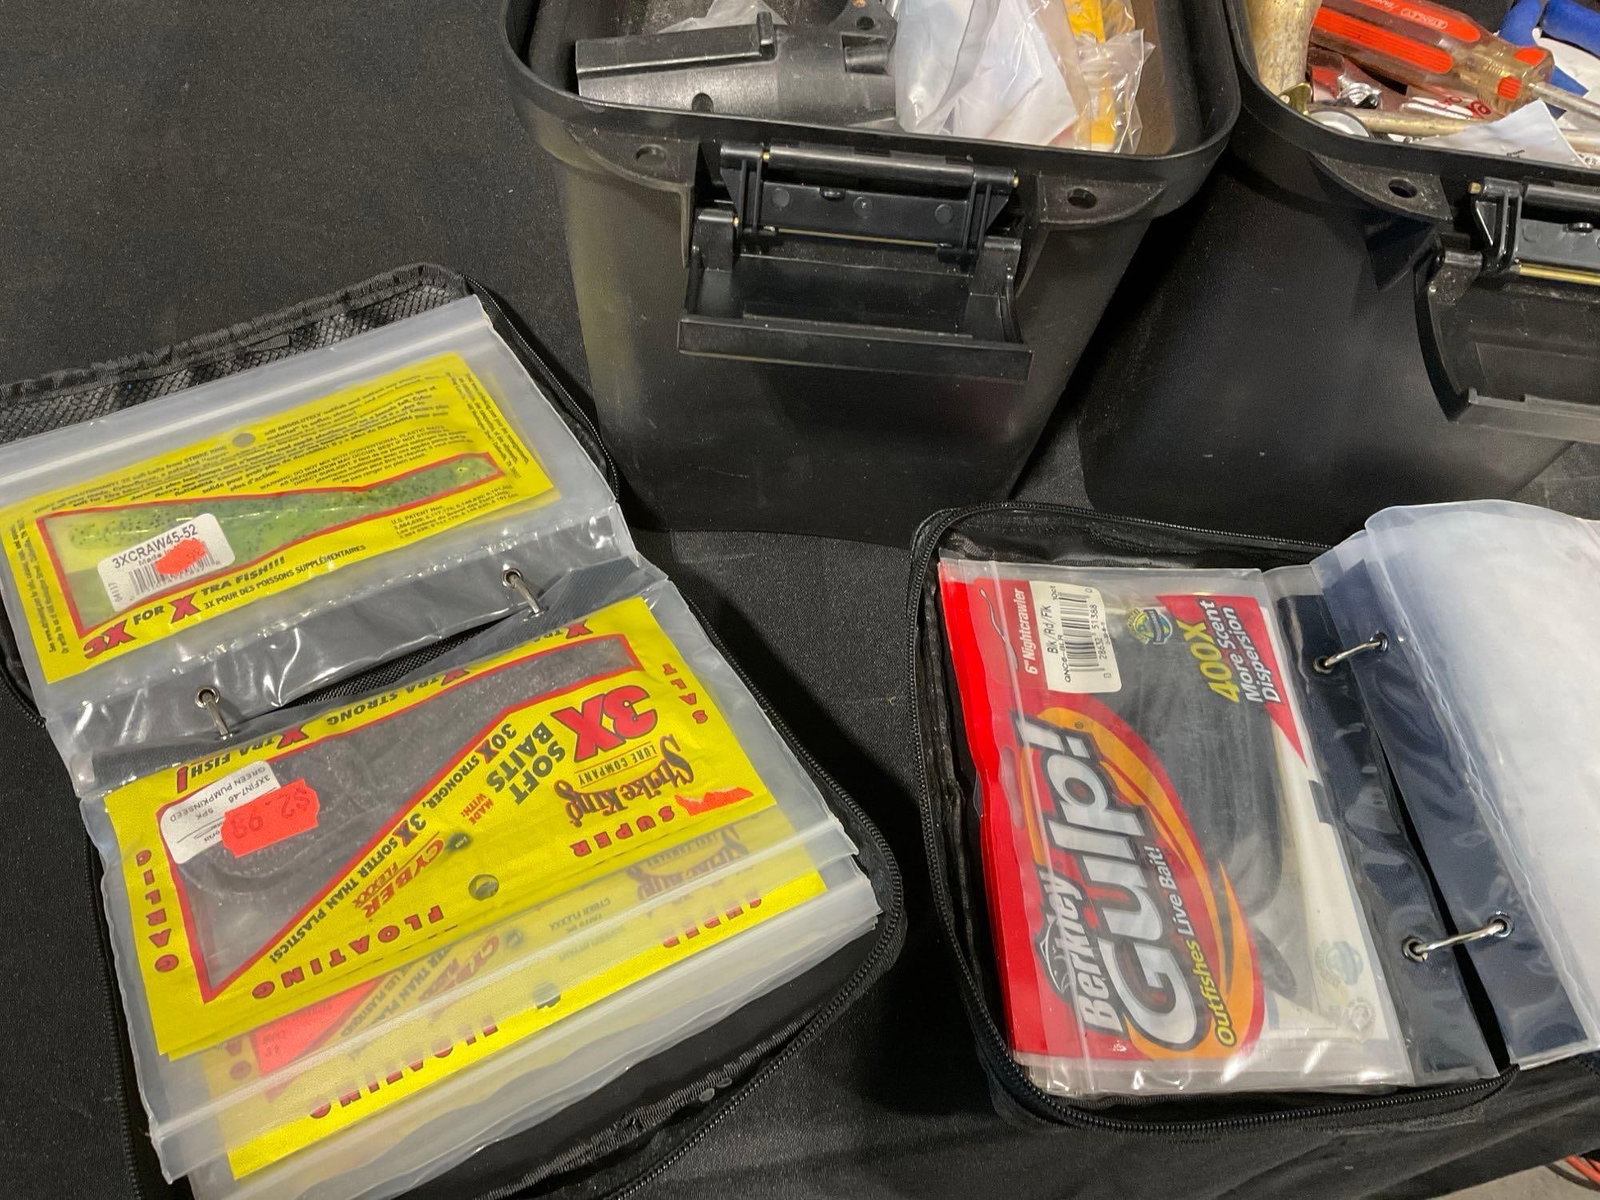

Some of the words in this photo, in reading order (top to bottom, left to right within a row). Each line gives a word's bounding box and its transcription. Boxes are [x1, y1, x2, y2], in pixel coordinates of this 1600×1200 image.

[404, 508, 429, 521] PATENT
[111, 523, 198, 569] 3XCRAW45-52
[137, 551, 162, 566] Made
[203, 599, 215, 609] 3X
[215, 591, 238, 604] POUR
[239, 584, 255, 596] DES
[255, 569, 295, 588] POISSONS
[295, 544, 366, 574] SUPPLÉMENTAIRES
[81, 619, 136, 658] 3X
[132, 605, 165, 625] FOR
[1014, 587, 1036, 660] Nightcrawler
[1039, 605, 1057, 653] Blk/Rd/Flk
[1199, 598, 1236, 649] Scent
[1175, 618, 1239, 702] 400X
[1221, 607, 1281, 702] Dispersion
[1228, 651, 1263, 701] More
[325, 691, 398, 727] STRONG
[661, 662, 708, 725] SALT
[473, 722, 516, 763] 30X
[549, 682, 660, 763] 3X
[233, 766, 266, 787] GREEN
[483, 720, 554, 793] BAITS
[504, 739, 567, 804] SOFT
[576, 756, 628, 785] COMPANY
[615, 732, 695, 809] Strike
[629, 744, 657, 764] LURE
[168, 782, 232, 822] PUMPKINSEED
[419, 752, 479, 809] STRONGER,
[458, 791, 486, 818] WITH:
[552, 777, 625, 826] King
[230, 787, 310, 838] $2.99
[390, 811, 426, 847] 3X
[466, 796, 493, 825] MADE
[567, 804, 674, 859] SUPER
[354, 837, 399, 878] SOFTER
[357, 838, 447, 918] CYBER
[1014, 718, 1197, 1043] Gulp!
[1143, 842, 1176, 892] Bait!
[323, 876, 359, 908] THAN
[348, 861, 400, 908] FLEXXX
[135, 850, 180, 972] GARLIC
[266, 904, 325, 963] PLASTICS!
[1162, 891, 1194, 939] Live
[247, 904, 444, 1001] FLOATING
[1036, 869, 1123, 1030] Berkley
[1184, 937, 1237, 1046] Outfishes
